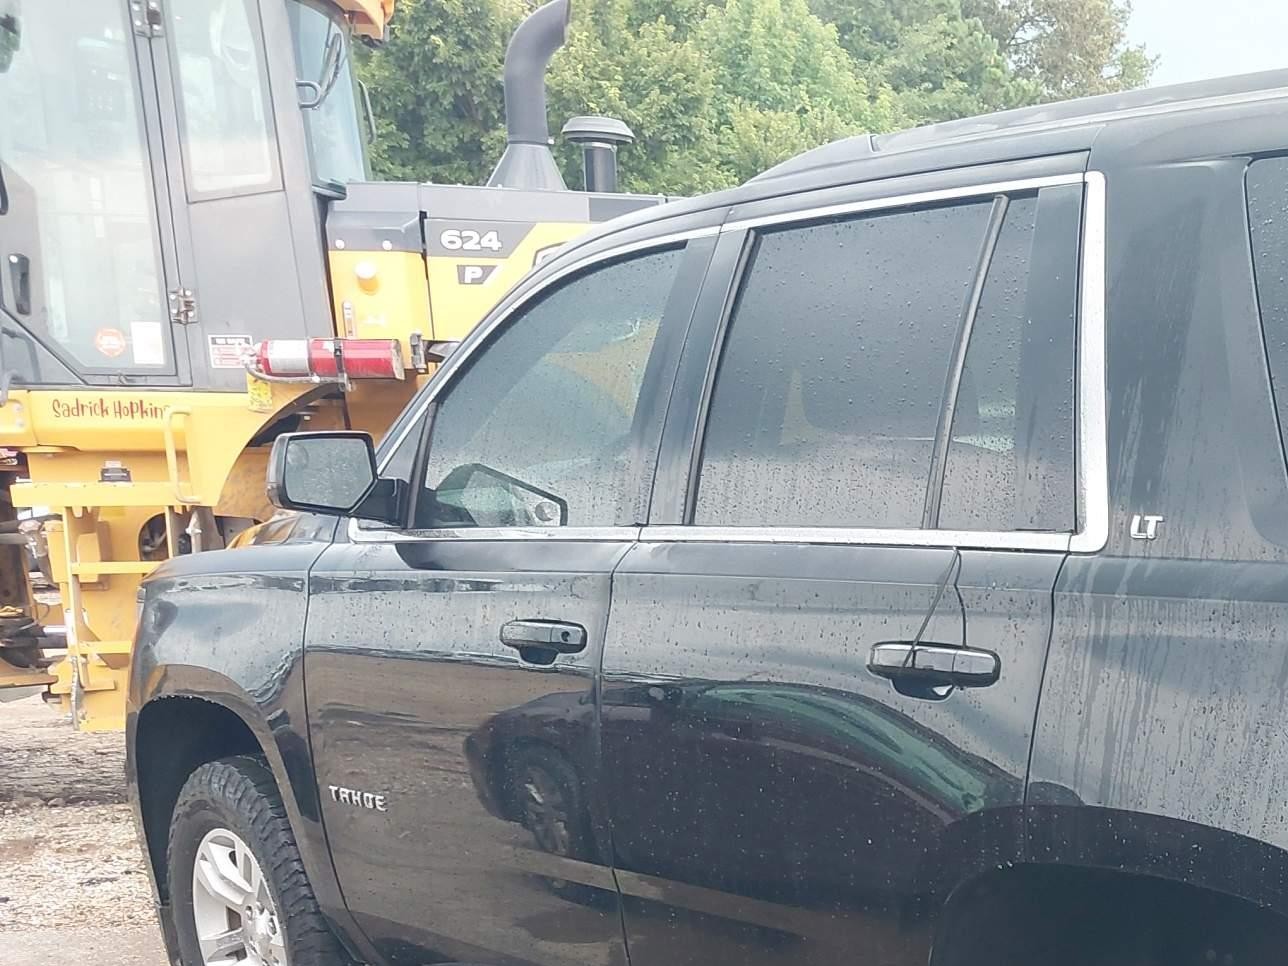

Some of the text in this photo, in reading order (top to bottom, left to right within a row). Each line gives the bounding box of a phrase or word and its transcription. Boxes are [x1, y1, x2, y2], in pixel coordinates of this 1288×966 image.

[440, 229, 502, 251] 624
[464, 266, 483, 284] P
[52, 398, 109, 418] Sadrick
[1130, 514, 1164, 539] LT
[328, 785, 386, 812] TAHOE
